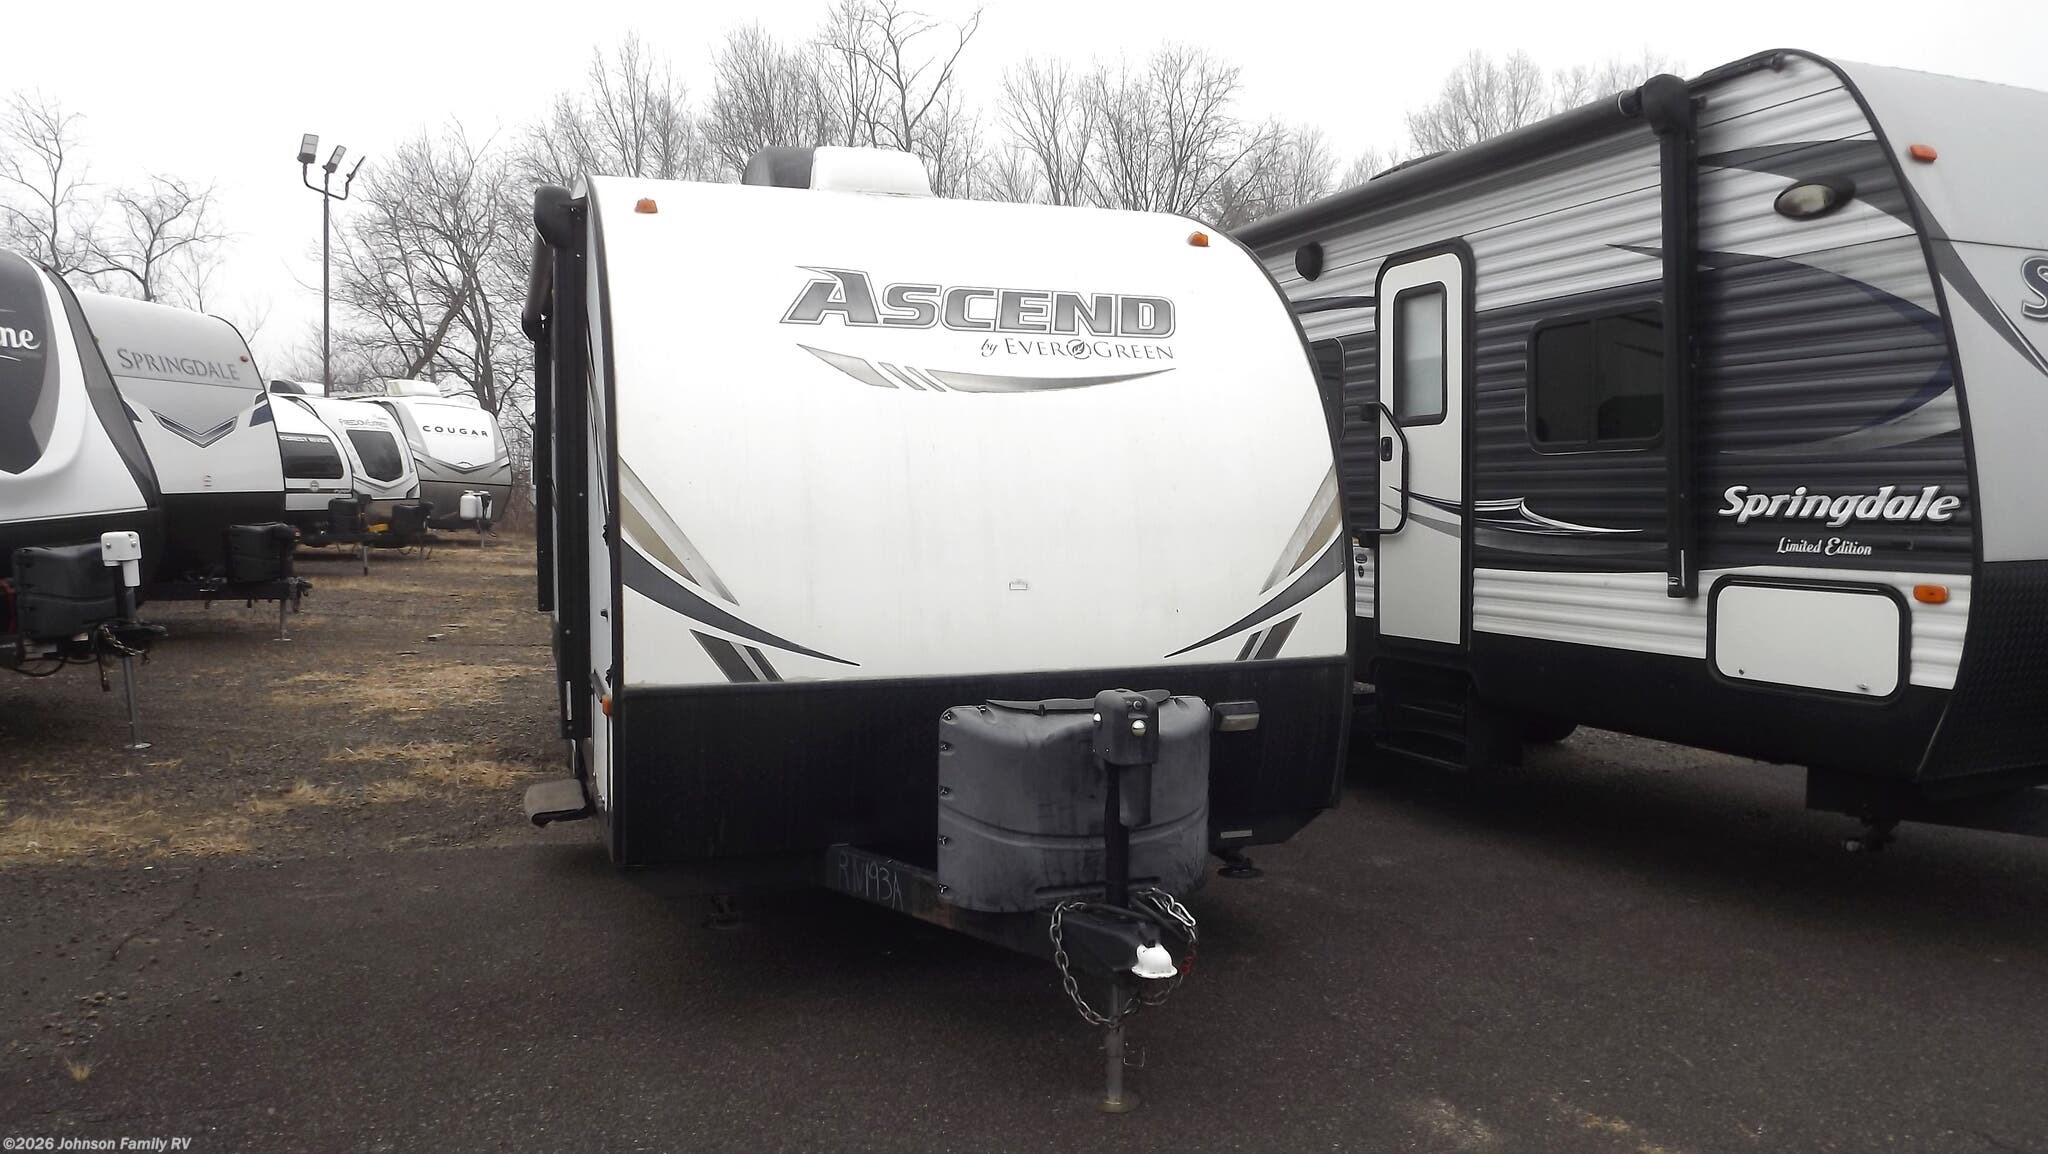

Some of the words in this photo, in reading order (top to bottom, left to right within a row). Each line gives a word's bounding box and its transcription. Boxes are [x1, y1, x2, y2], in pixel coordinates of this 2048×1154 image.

[780, 265, 1176, 339] ASCEND
[980, 338, 998, 358] by
[116, 347, 241, 381] SPRINGDALE
[422, 424, 489, 438] COUGAR
[1718, 485, 1961, 528] Springdale
[1776, 536, 1822, 554] Limited
[1824, 536, 1873, 556] Edition
